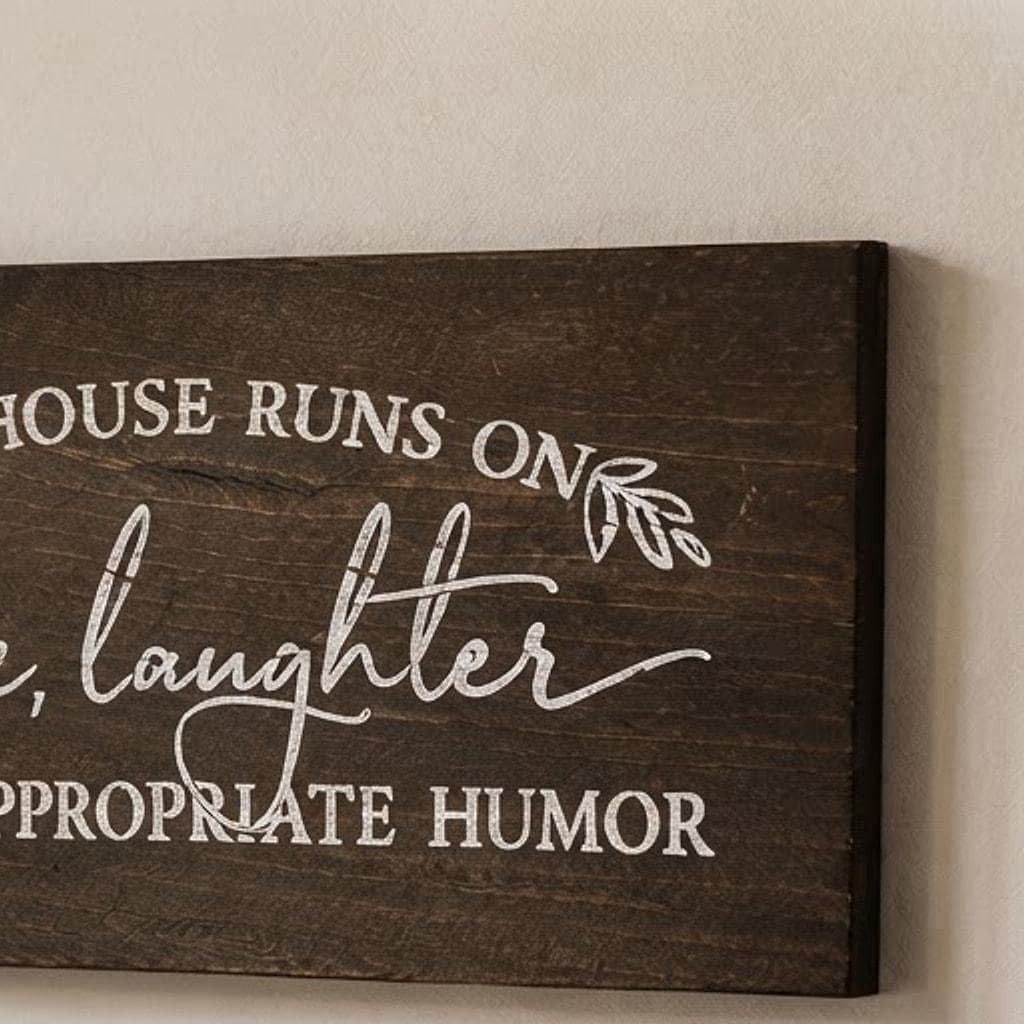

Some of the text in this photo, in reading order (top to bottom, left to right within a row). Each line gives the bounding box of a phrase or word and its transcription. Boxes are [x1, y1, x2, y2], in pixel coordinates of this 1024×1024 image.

[245, 380, 446, 460] RUNS
[472, 420, 597, 501] ON
[81, 501, 712, 834] laughter
[428, 786, 716, 857] HUMOR
